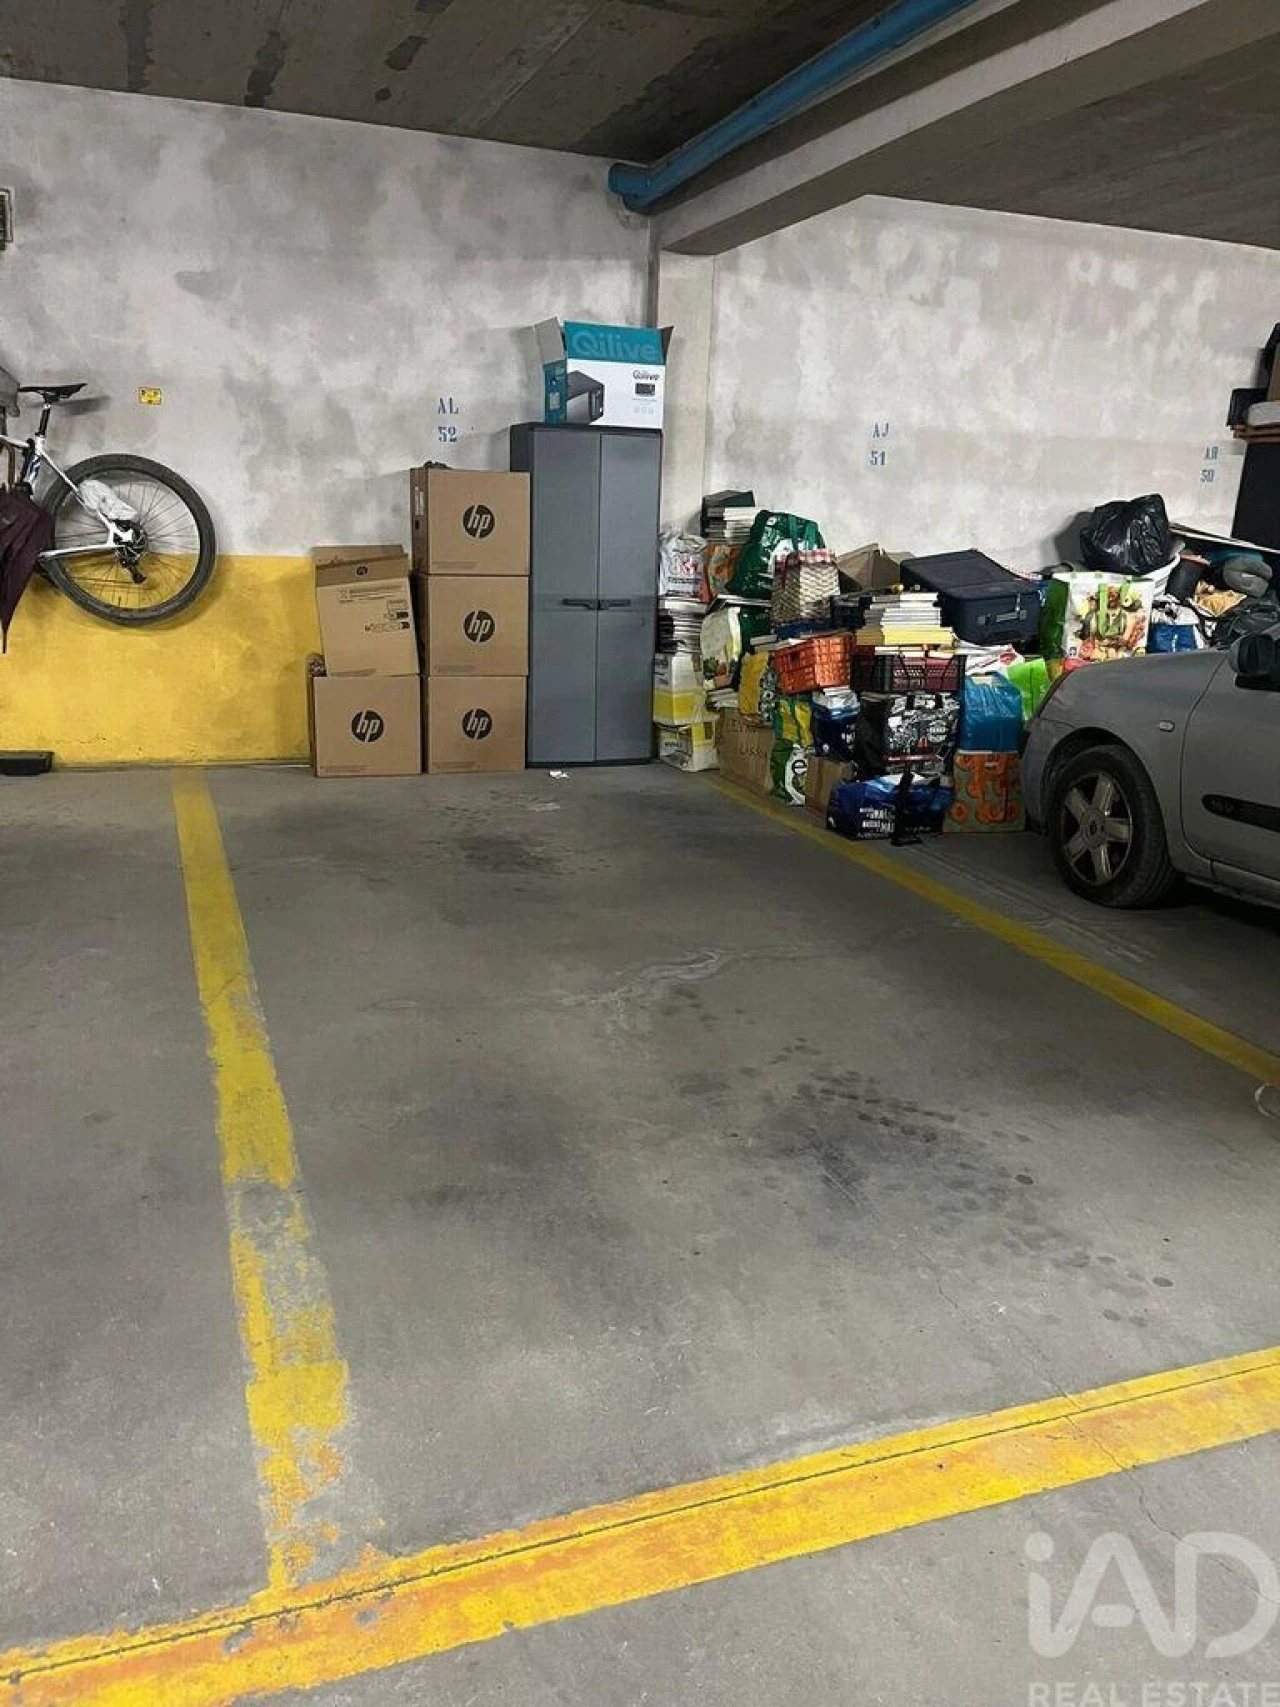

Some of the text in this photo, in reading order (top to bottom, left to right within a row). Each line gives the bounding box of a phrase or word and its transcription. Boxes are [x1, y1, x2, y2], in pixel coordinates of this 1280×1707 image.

[571, 329, 657, 360] Qilive
[437, 397, 459, 414] AL
[437, 426, 457, 443] 52
[872, 422, 889, 438] AJ
[870, 450, 886, 466] 51
[466, 504, 491, 538] hp
[466, 609, 492, 643] hp
[355, 709, 381, 743] hp
[464, 707, 490, 740] hp
